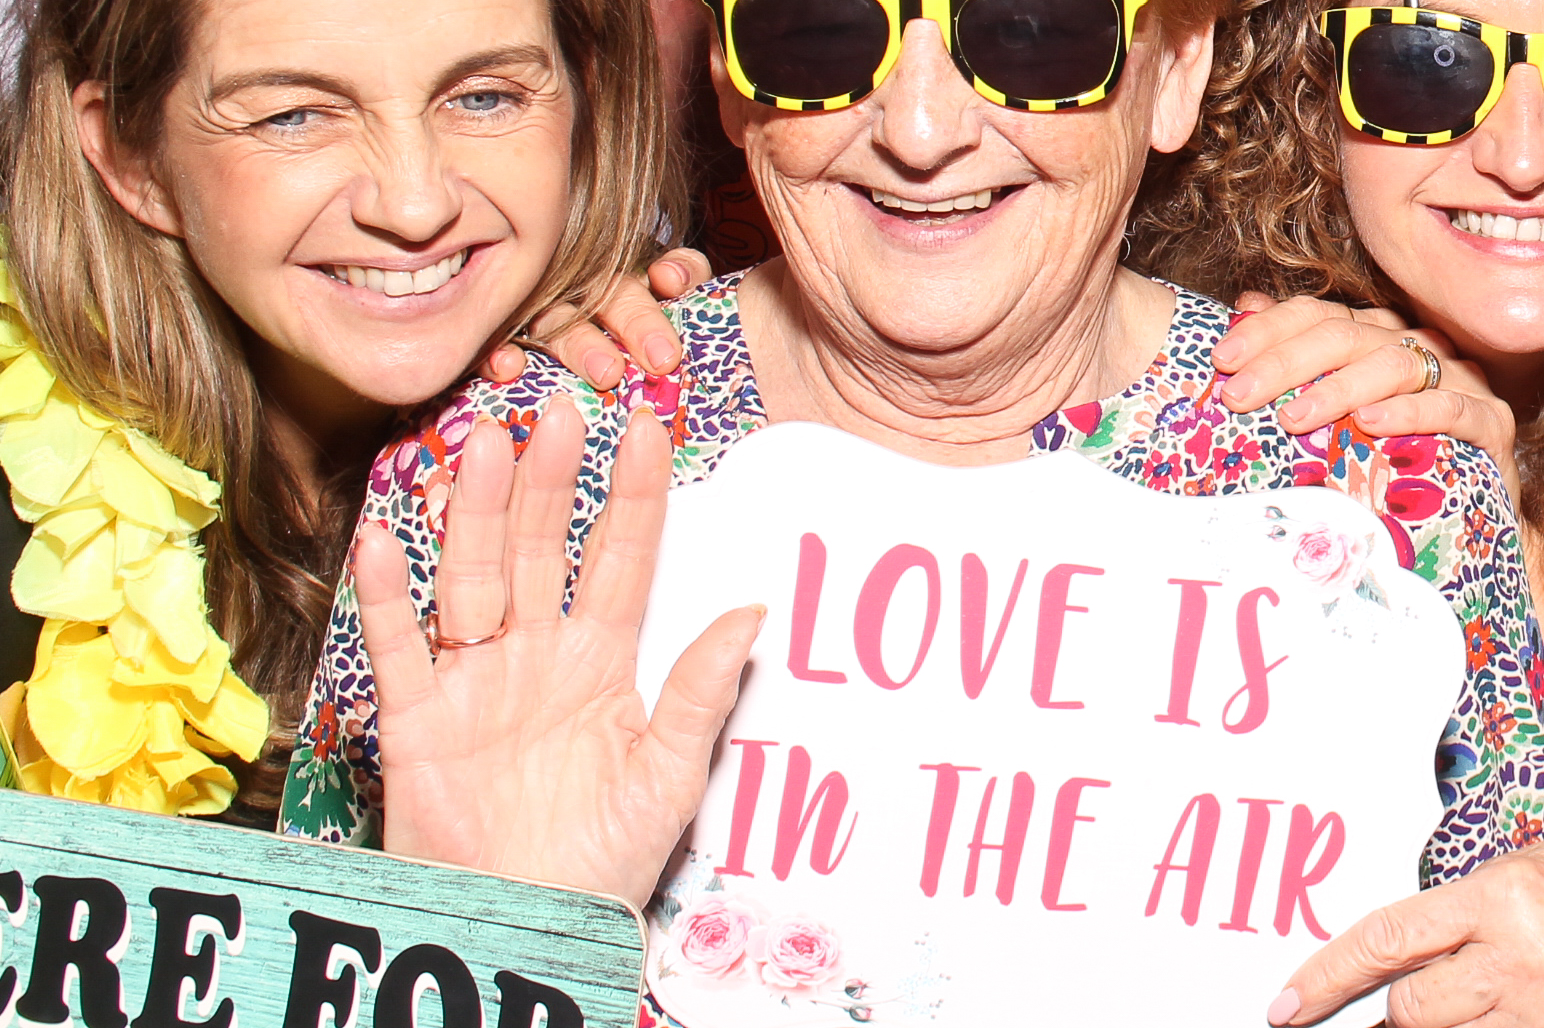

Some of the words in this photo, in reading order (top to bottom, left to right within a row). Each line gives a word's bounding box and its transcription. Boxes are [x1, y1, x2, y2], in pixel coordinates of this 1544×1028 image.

[785, 532, 1106, 711] LOVE
[1153, 577, 1290, 736] IS
[918, 761, 1112, 913] THE
[1143, 792, 1347, 942] AIR
[0, 871, 242, 1028] RE
